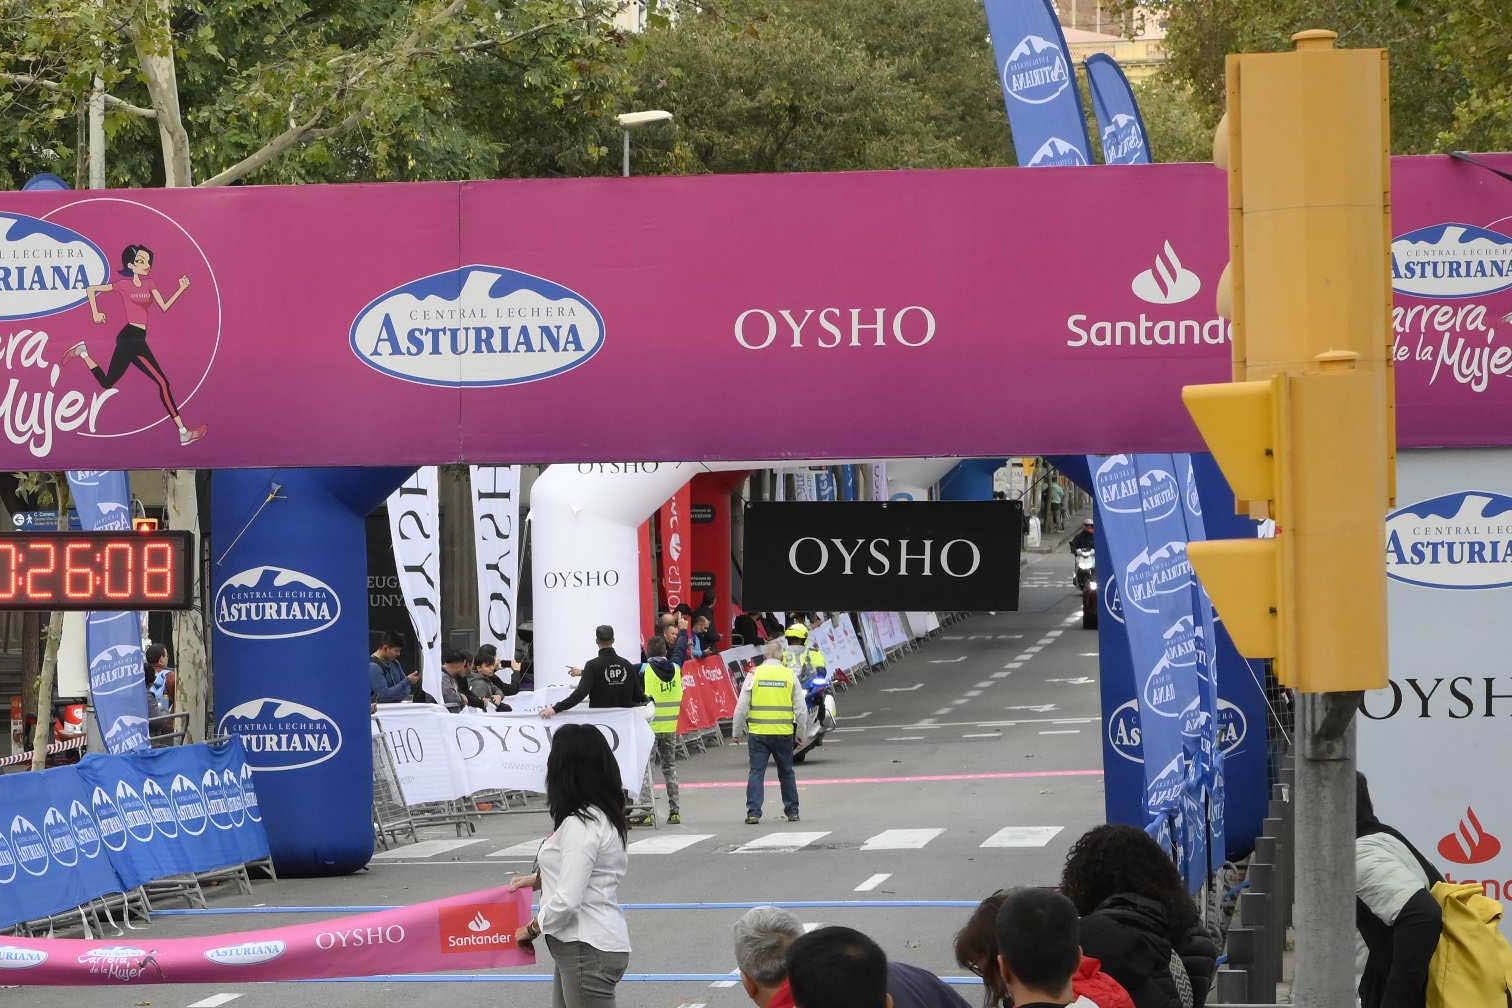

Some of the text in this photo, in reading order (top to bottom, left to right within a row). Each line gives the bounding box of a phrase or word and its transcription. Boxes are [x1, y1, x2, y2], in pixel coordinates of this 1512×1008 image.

[13, 248, 84, 259] LECHERA
[1407, 249, 1457, 257] CENTRAL
[410, 307, 577, 320] CENTRAL LECHERA
[1393, 304, 1487, 333] arrera
[370, 313, 585, 357] ASTURIANA
[734, 306, 936, 350] OYSHO
[1413, 526, 1480, 535] CENTRAL
[789, 537, 981, 577] OYSHO
[544, 570, 619, 589] OYSHO
[278, 591, 326, 599] LECHERA
[219, 596, 331, 622] ASTURIANA
[278, 722, 327, 730] LECHERA
[211, 943, 280, 958] ASTURIANA
[316, 925, 405, 950] OYSHO
[448, 933, 511, 947] Santander
